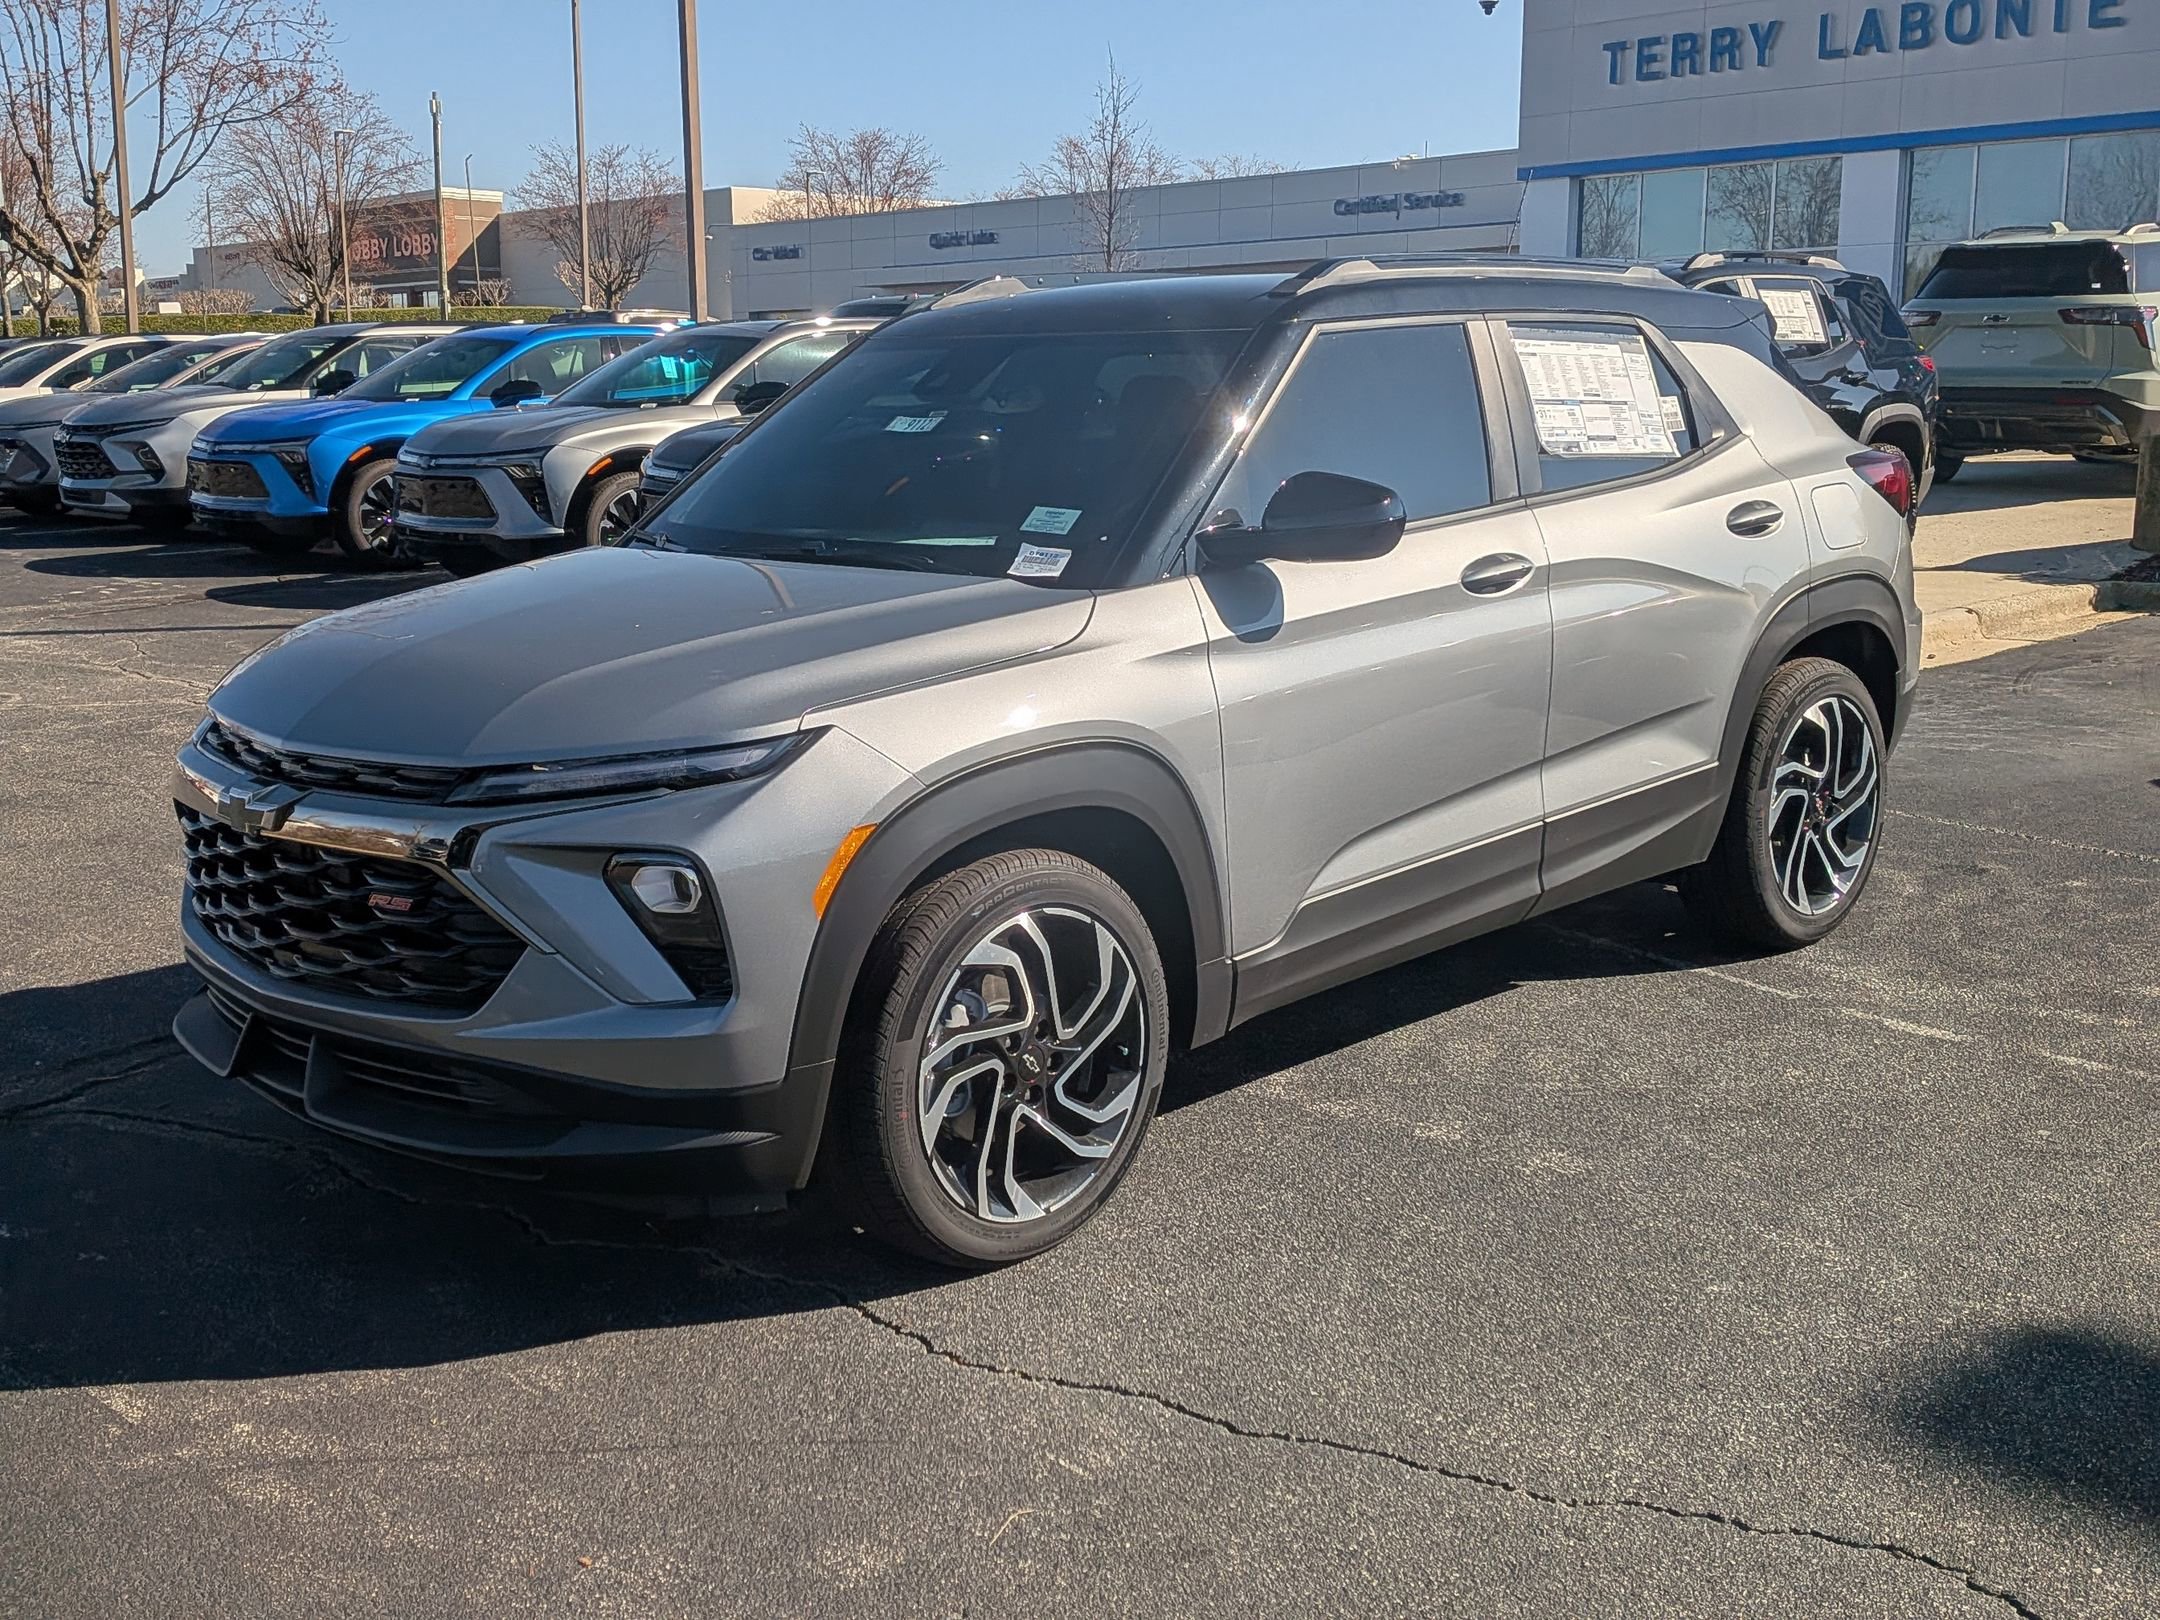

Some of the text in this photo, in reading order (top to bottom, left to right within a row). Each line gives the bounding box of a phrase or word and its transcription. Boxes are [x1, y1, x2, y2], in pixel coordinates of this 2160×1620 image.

[1602, 0, 2129, 85] TERRY LABONTE
[1403, 192, 1464, 210] Service
[346, 232, 439, 264] OBBY LOBBY
[368, 892, 413, 911] RS
